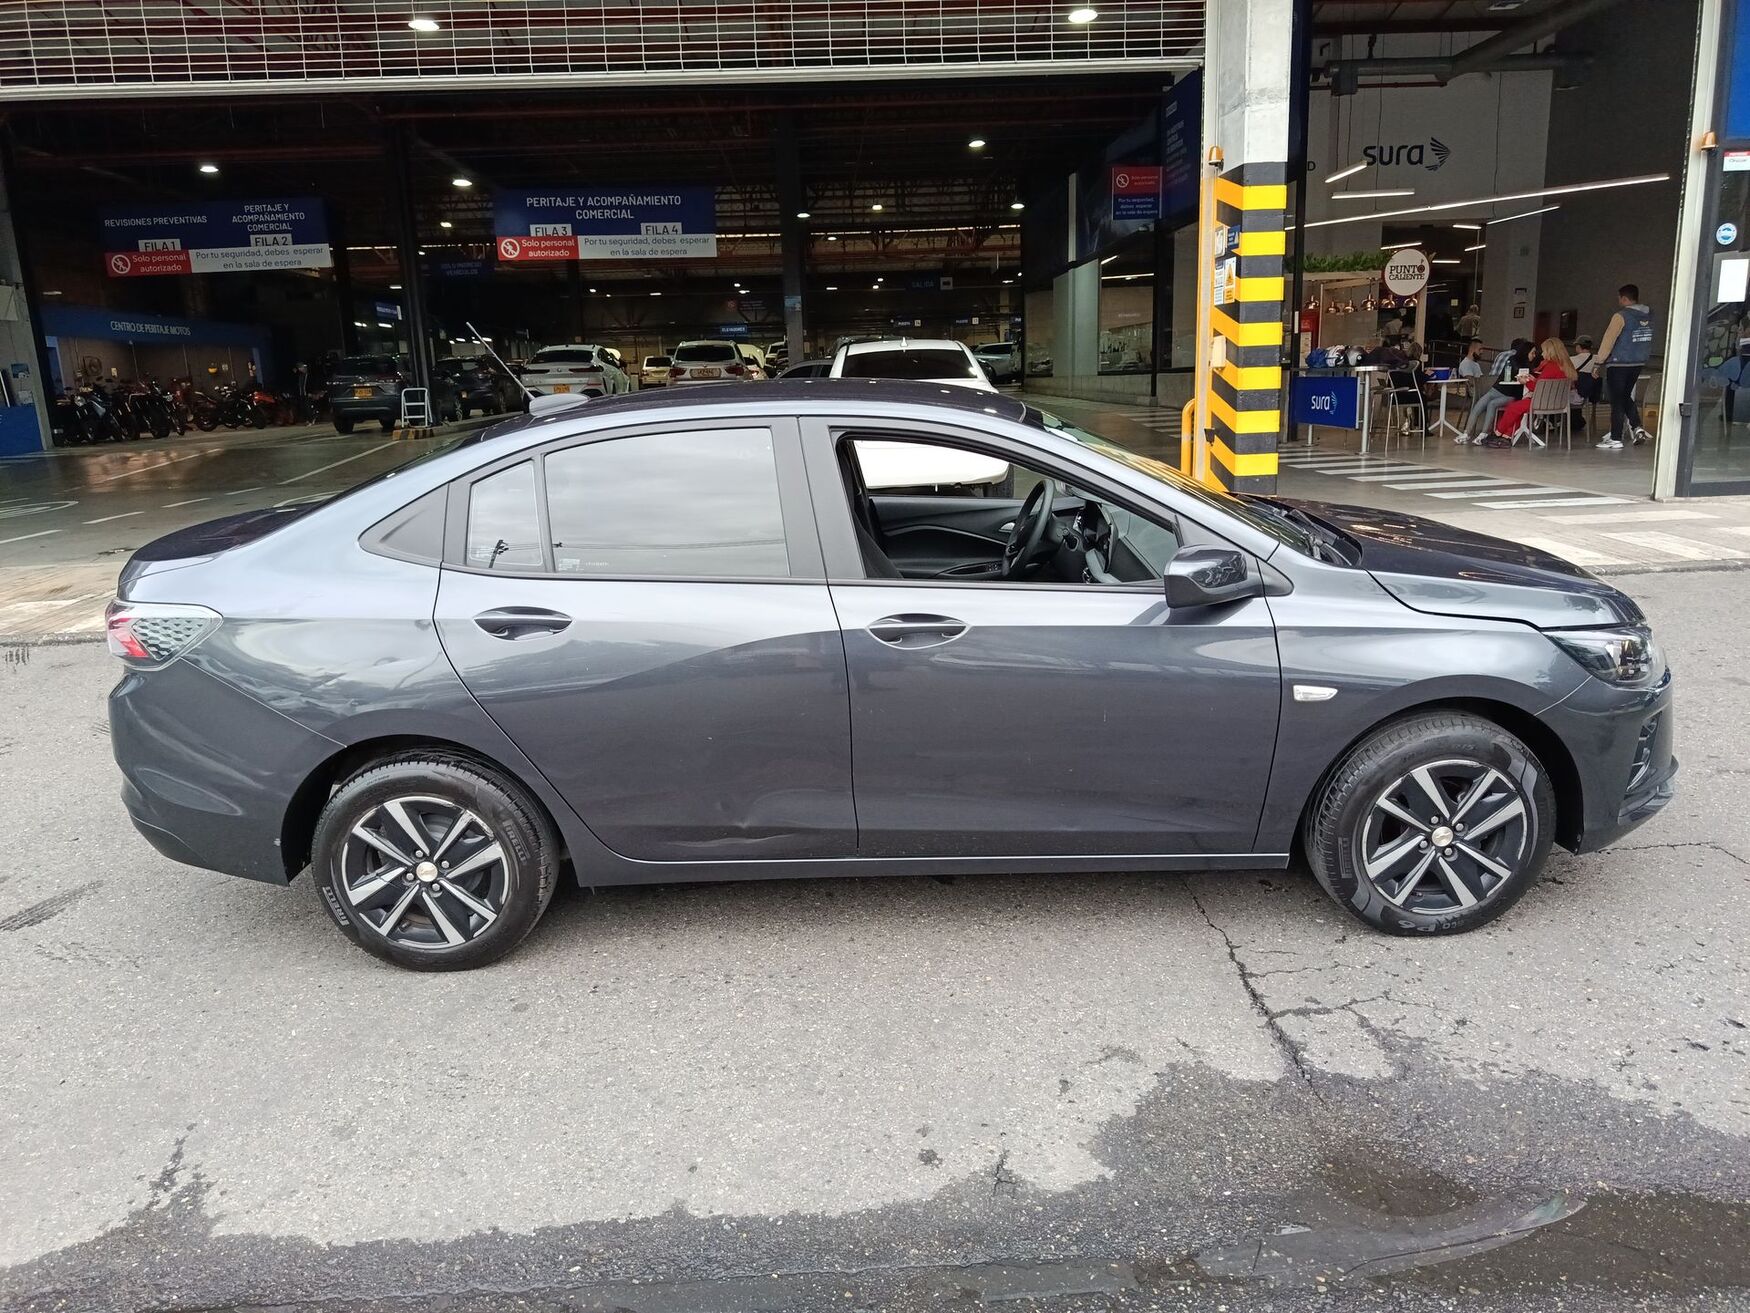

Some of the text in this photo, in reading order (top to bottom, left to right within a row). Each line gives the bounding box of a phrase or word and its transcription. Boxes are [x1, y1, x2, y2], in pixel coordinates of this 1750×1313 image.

[1363, 144, 1424, 166] sura
[526, 194, 681, 207] PERITAJE Y ACOMPAÑAMIENTO
[244, 203, 289, 213] PERITAJE Y
[232, 211, 305, 223] ACOMPAÑAMIENTO
[576, 209, 635, 219] COMERCIAL
[104, 215, 208, 227] REVISIONES PREVENTIVAS
[247, 222, 293, 232] COMERCIAL
[535, 226, 567, 236] FILA 3
[645, 225, 678, 235] FILA 4
[144, 241, 175, 251] FILA 1
[255, 236, 288, 246] FILA 2
[522, 239, 575, 248] Solo personal
[584, 237, 599, 245] Por
[599, 237, 607, 245] tu
[652, 236, 677, 244] debes
[680, 237, 709, 246] esperar
[196, 251, 209, 259] Por
[211, 250, 219, 259] tu
[264, 247, 290, 256] debes
[293, 247, 323, 257] esperar
[528, 249, 570, 257] autorizado
[622, 248, 629, 256] la
[648, 247, 659, 255] de
[660, 248, 688, 257] espera
[132, 253, 186, 264] Solo personal
[235, 260, 243, 268] la
[244, 260, 261, 268] sala
[262, 259, 273, 267] de
[274, 259, 302, 268] espera
[140, 263, 182, 273] autorizado
[1390, 264, 1425, 274] PUNTO
[1389, 273, 1425, 281] CALIENTE
[110, 320, 136, 332] CENTRO
[136, 322, 145, 333] DE
[1311, 395, 1330, 411] sura
